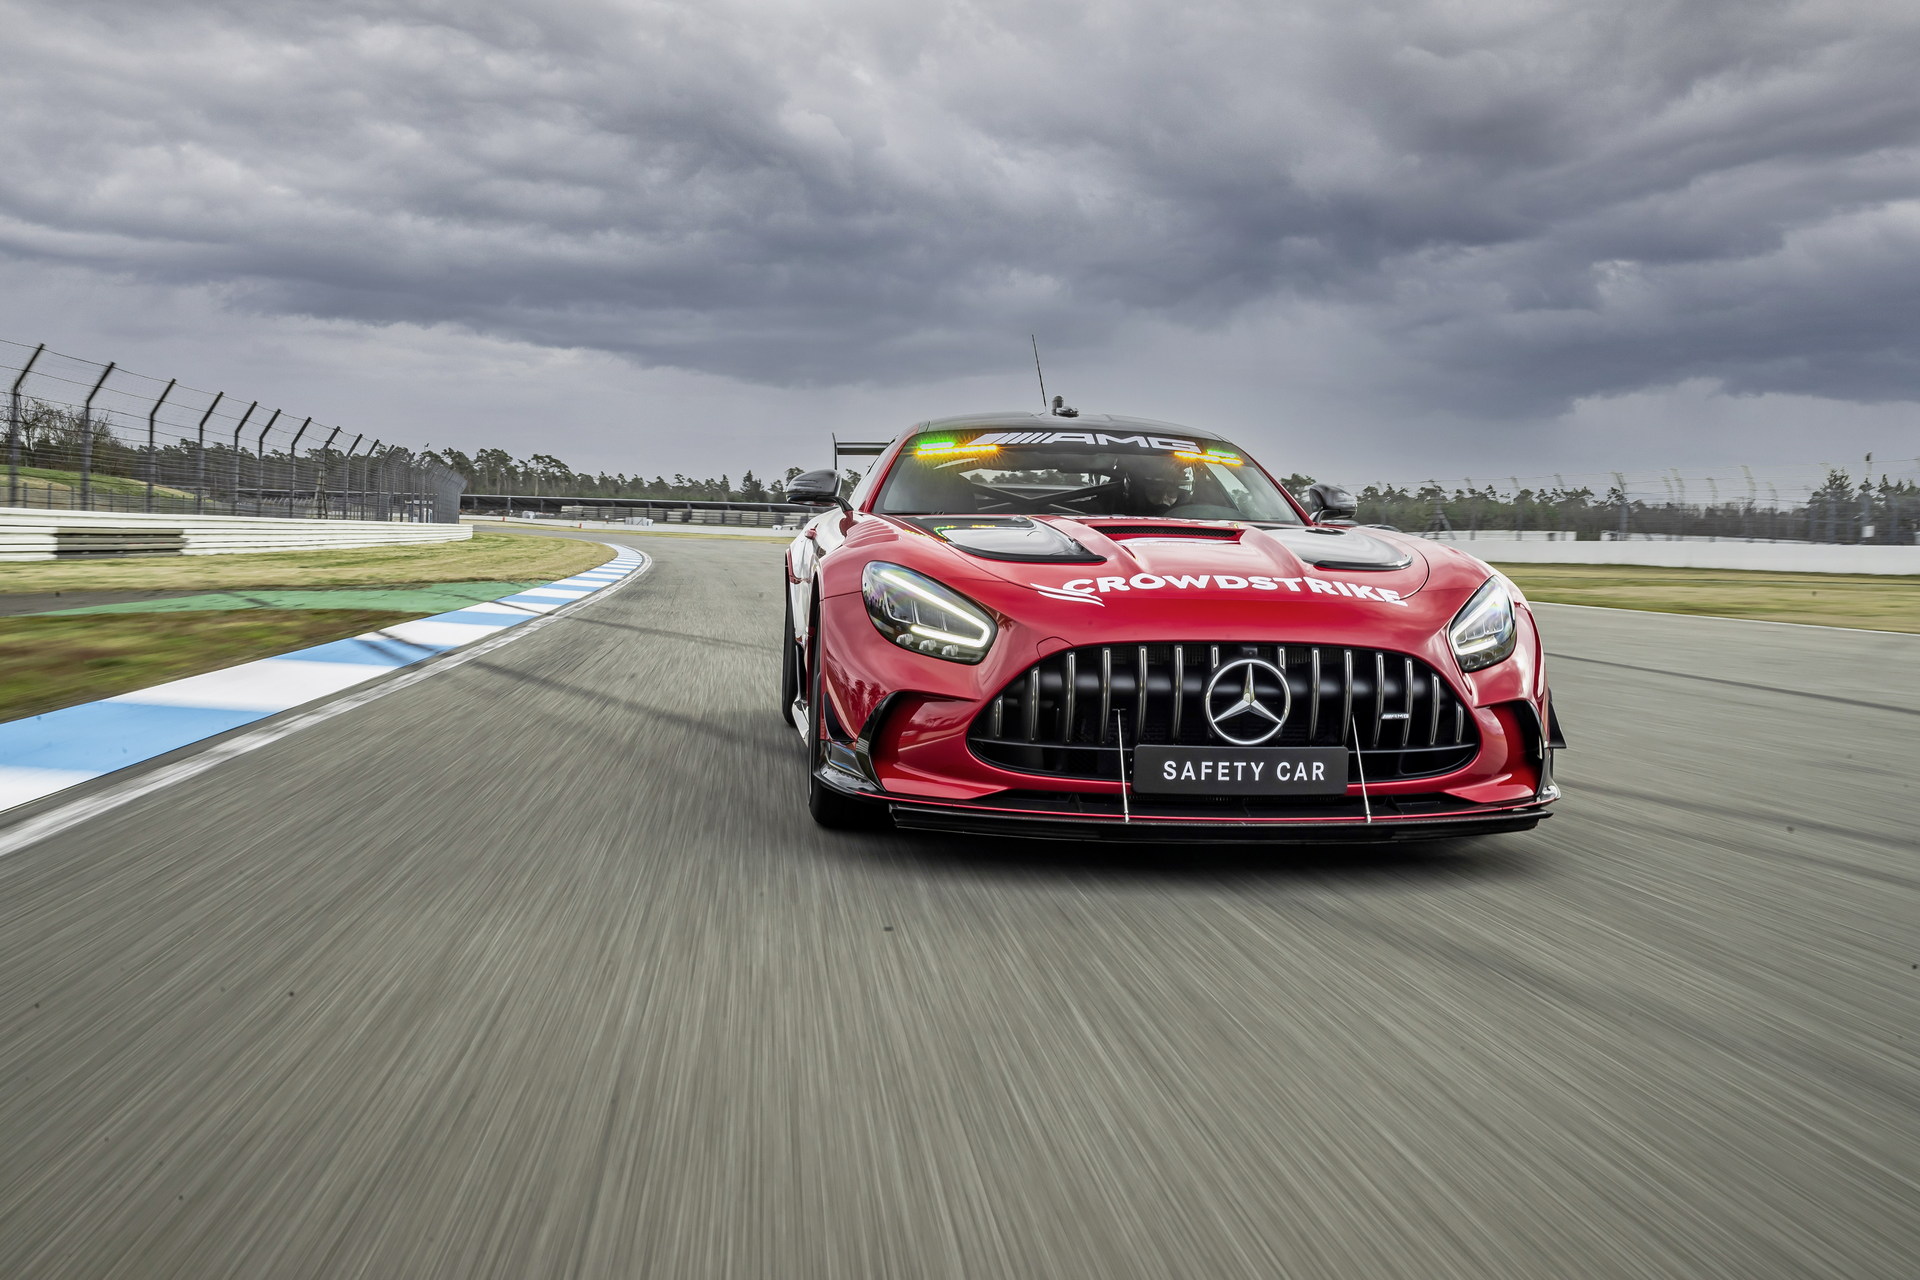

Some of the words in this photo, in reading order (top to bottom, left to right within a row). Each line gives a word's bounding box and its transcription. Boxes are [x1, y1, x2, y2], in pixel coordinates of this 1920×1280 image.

[1042, 432, 1202, 454] AMG
[1062, 573, 1409, 607] CROWDSTRIKE
[1163, 760, 1264, 781] SAFETY
[1276, 762, 1325, 781] CAR
